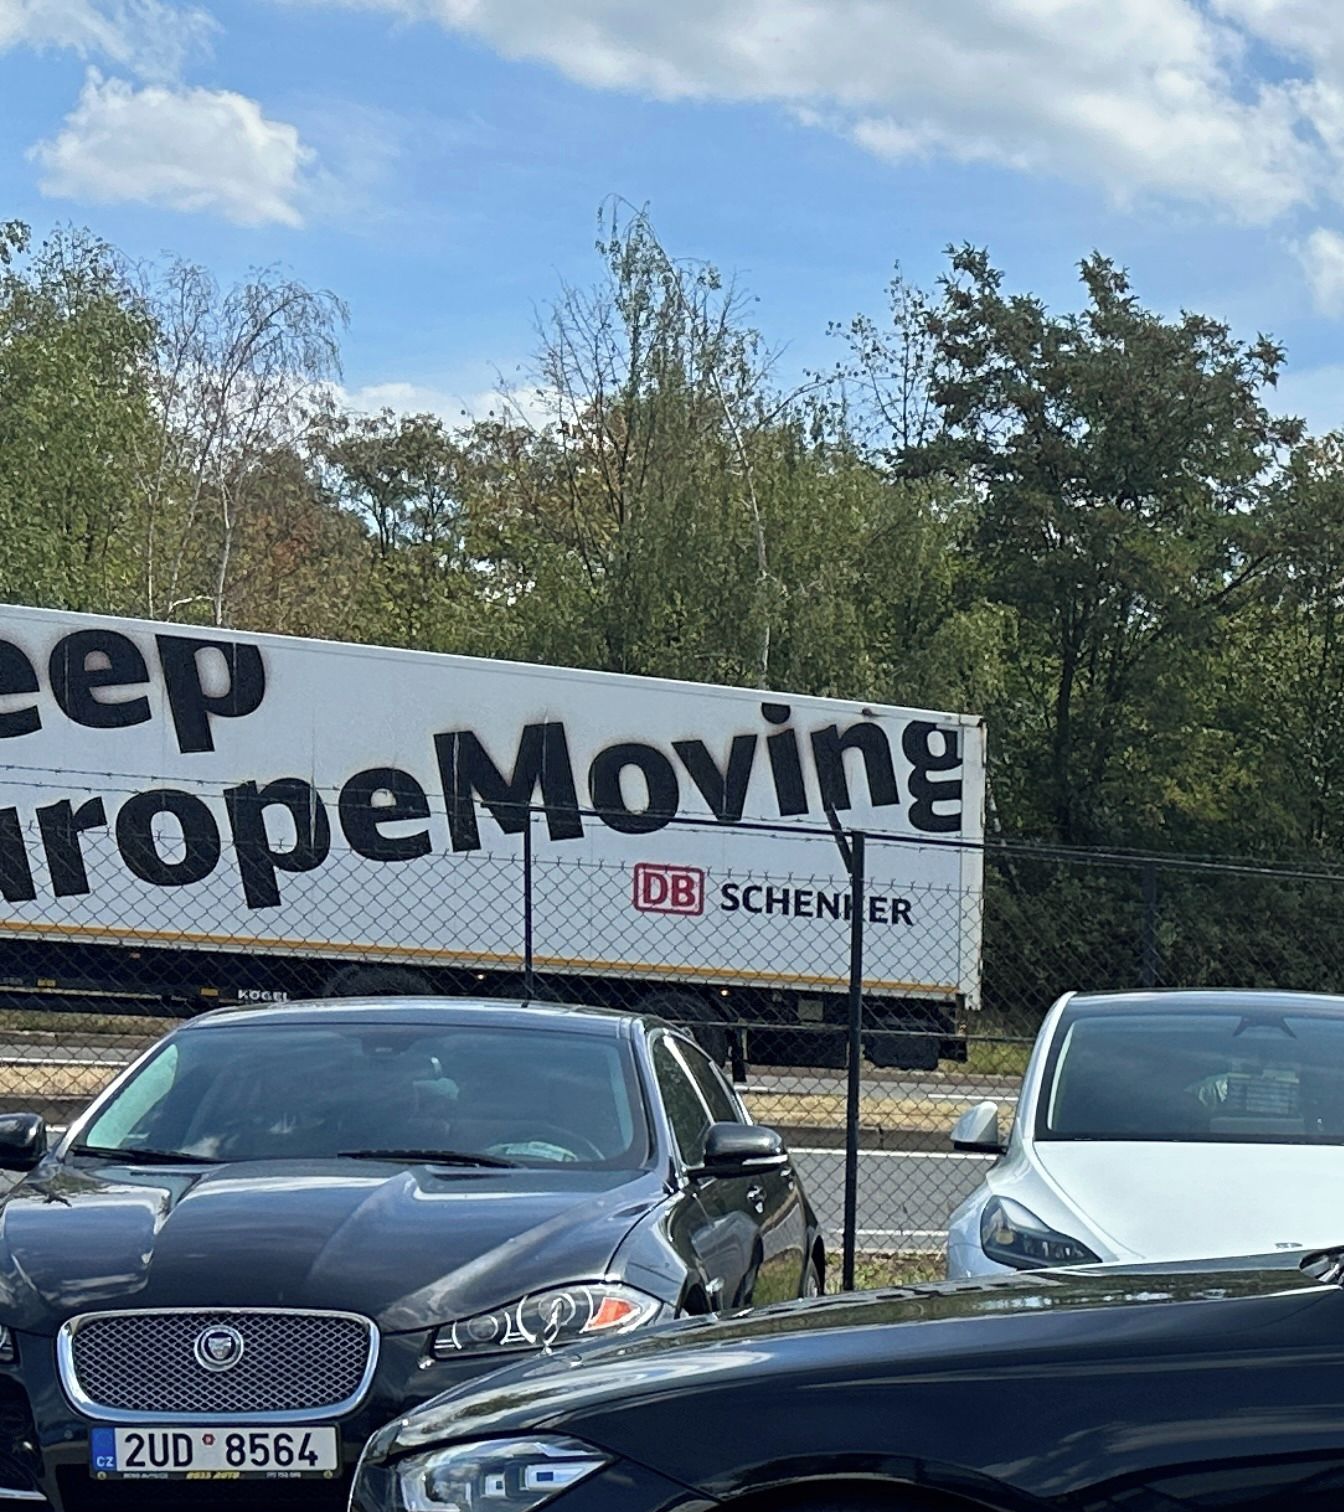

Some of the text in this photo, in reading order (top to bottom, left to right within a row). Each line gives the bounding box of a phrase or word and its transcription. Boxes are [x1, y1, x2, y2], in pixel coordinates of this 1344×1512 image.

[639, 868, 700, 911] DB
[96, 1456, 115, 1468] CZ
[124, 1432, 319, 1468] 2UD 8564
